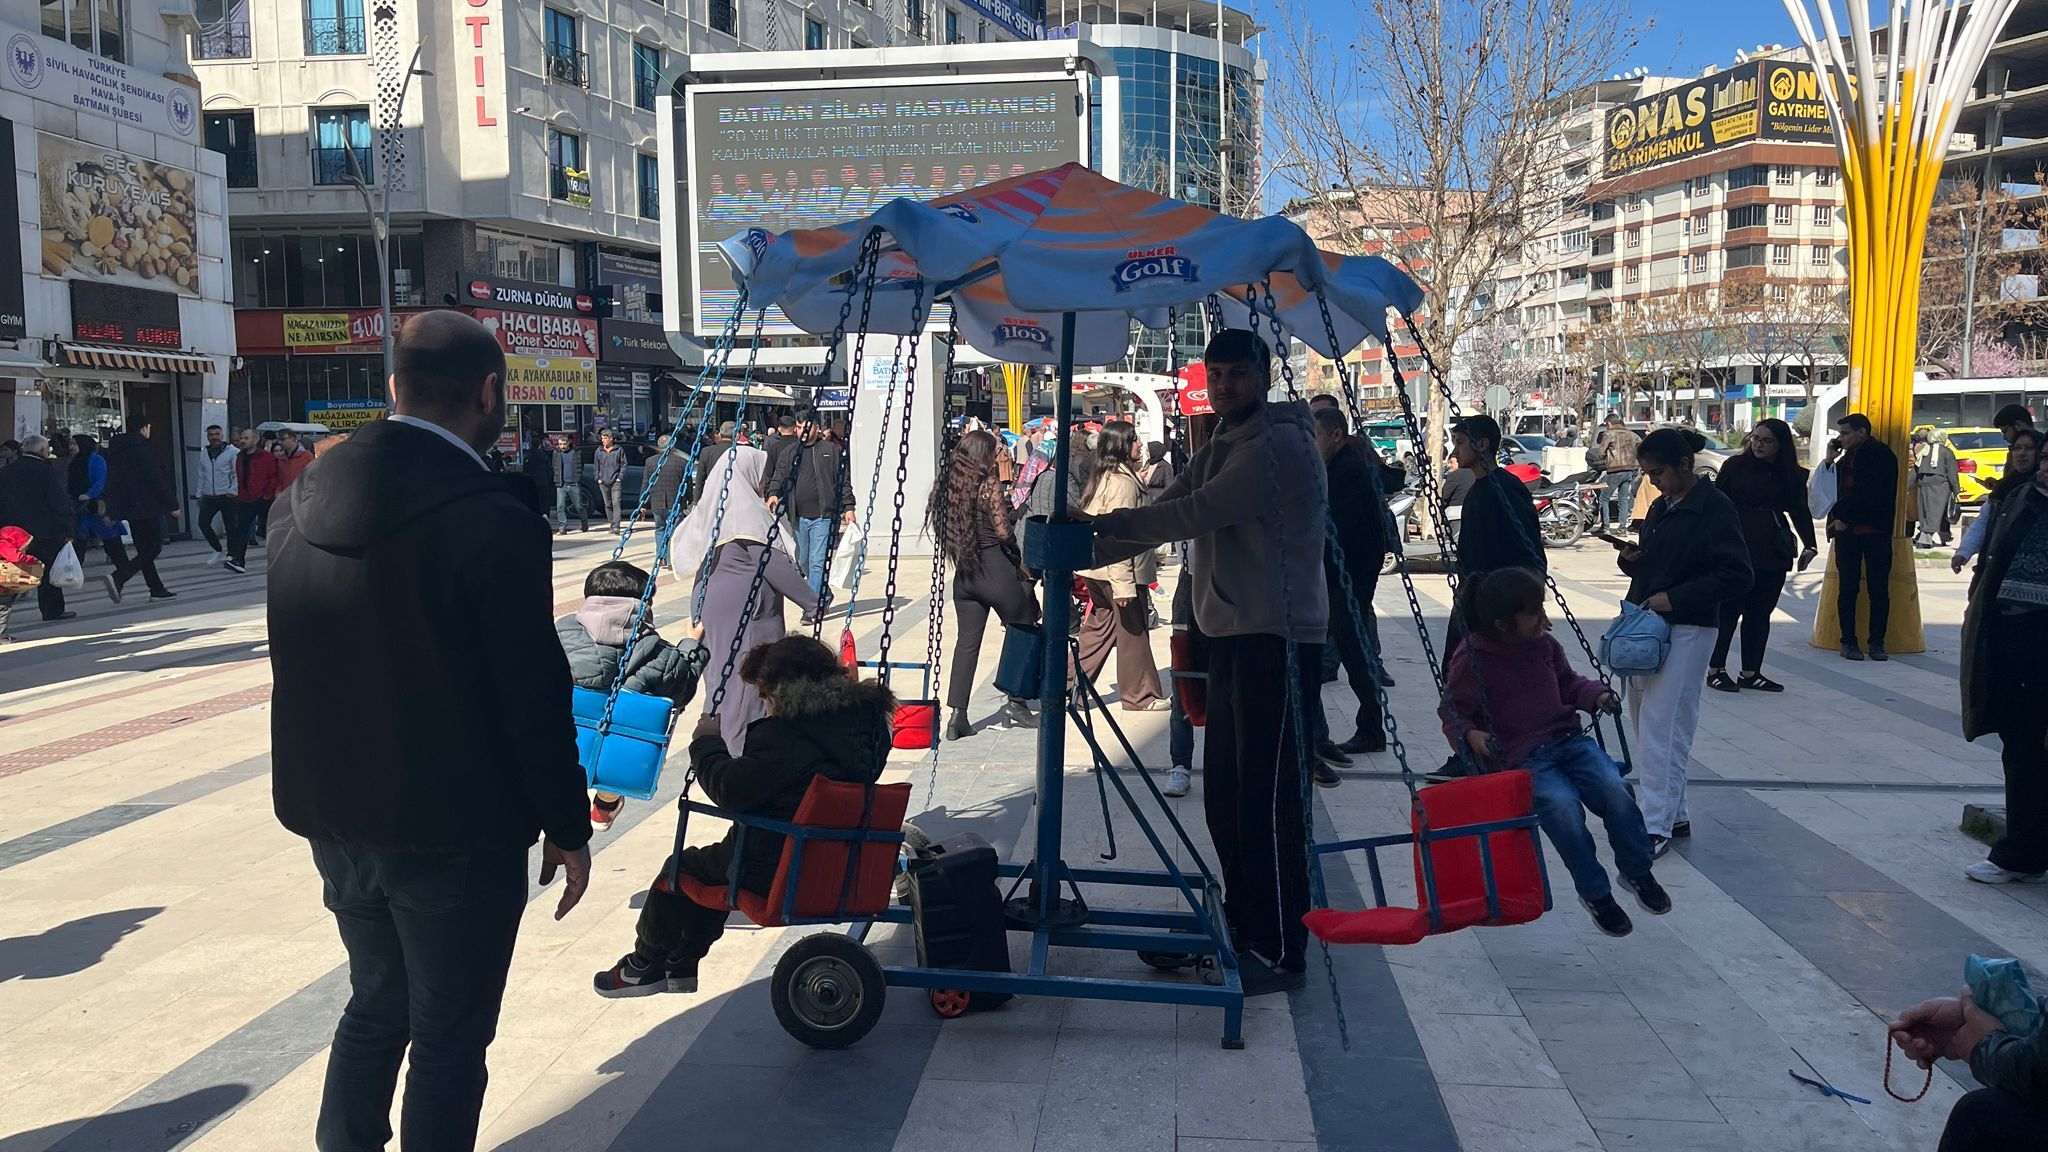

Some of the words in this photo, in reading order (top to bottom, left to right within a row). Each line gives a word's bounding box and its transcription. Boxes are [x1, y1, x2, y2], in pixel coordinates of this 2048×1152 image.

[88, 57, 127, 79] TÜRKİYE
[464, 0, 497, 127] TIL
[46, 57, 70, 73] SİVİL
[72, 66, 118, 89] HAVACILIK
[121, 83, 165, 104] SENDİKASI
[91, 86, 125, 106] HAVA-İŞ
[73, 94, 109, 114] BATMAN
[112, 107, 143, 123] ŞUBESİ
[719, 103, 814, 123] BATMAN
[820, 99, 887, 120] ZİLAN
[896, 92, 1056, 117] HASTAHANESİ
[1611, 87, 1706, 150] ONAS
[1804, 124, 1822, 133] Lider
[103, 154, 137, 181] SEÇ
[67, 169, 171, 211] KURUYEMİŞ
[1120, 258, 1184, 282] Golf
[496, 288, 532, 305] ZURNA
[535, 291, 573, 309] DÜRÜM
[352, 312, 384, 338] 400
[502, 312, 582, 337] HACIBABA
[288, 332, 301, 342] NE
[304, 331, 348, 342] ALIRSAN
[507, 332, 540, 347] Döner
[543, 335, 579, 350] Salonu
[624, 336, 639, 348] Türk
[640, 339, 668, 350] Telekom
[523, 370, 581, 383] AYAKKABILAR
[583, 371, 593, 383] NE
[550, 387, 574, 400] 400
[577, 387, 591, 400] TL
[313, 411, 371, 421] MAĞAZAMIZDA
[327, 402, 365, 410] Bayrama
